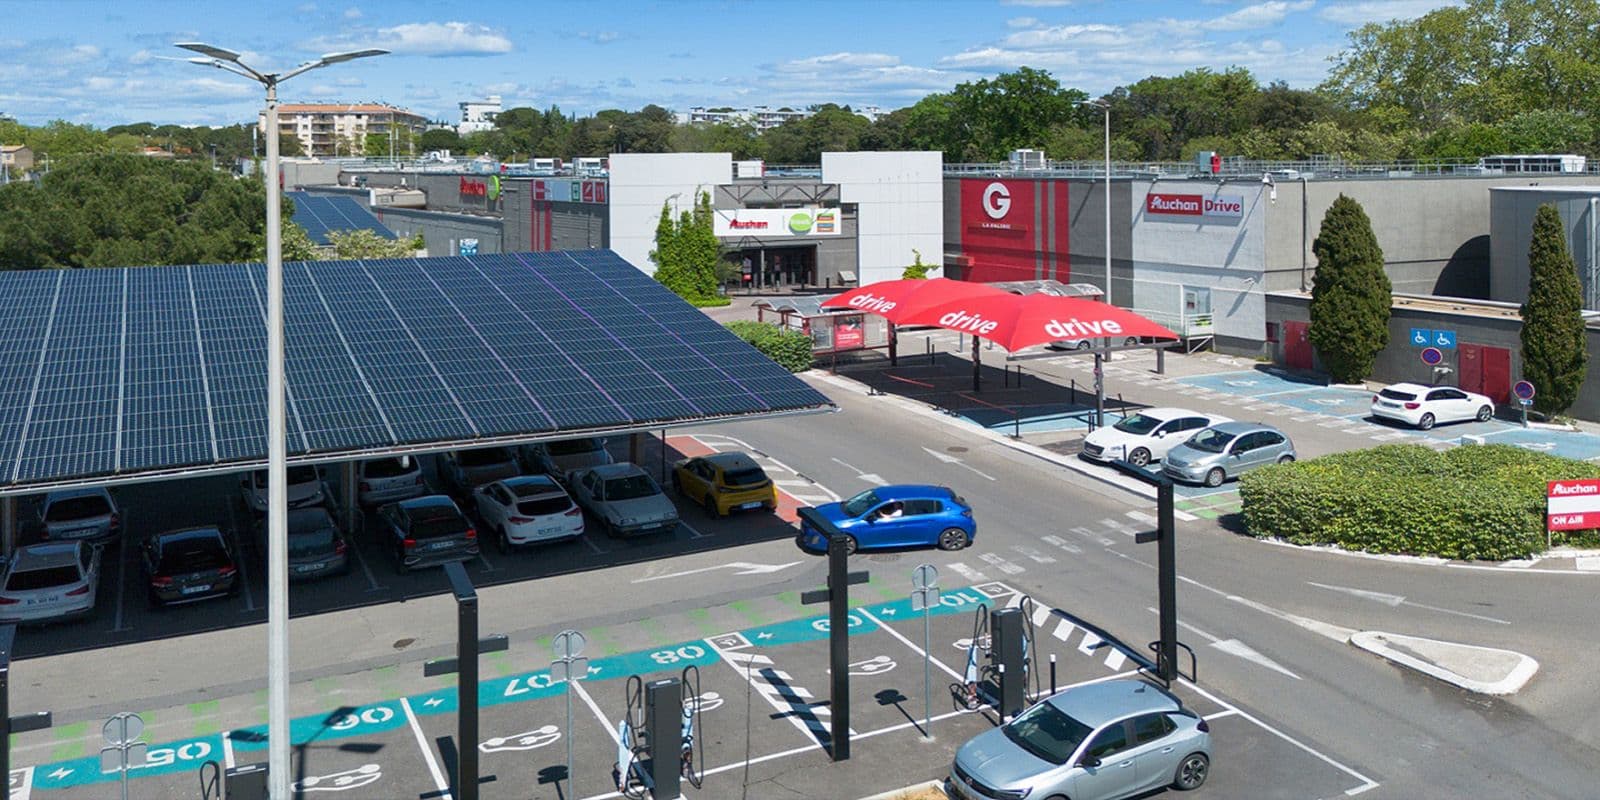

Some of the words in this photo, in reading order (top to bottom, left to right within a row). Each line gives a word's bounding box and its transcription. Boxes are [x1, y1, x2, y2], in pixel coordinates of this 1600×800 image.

[982, 182, 1012, 219] G
[1151, 195, 1198, 211] Auchan
[1204, 199, 1241, 212] Drive
[729, 218, 768, 229] Auchan
[848, 293, 897, 313] drive
[939, 311, 999, 334] drive
[1044, 318, 1124, 338] drive
[1552, 483, 1597, 494] Auchan
[1552, 515, 1566, 525] ON
[650, 646, 705, 664] 08
[504, 674, 552, 696] 07
[146, 742, 211, 768] 05
